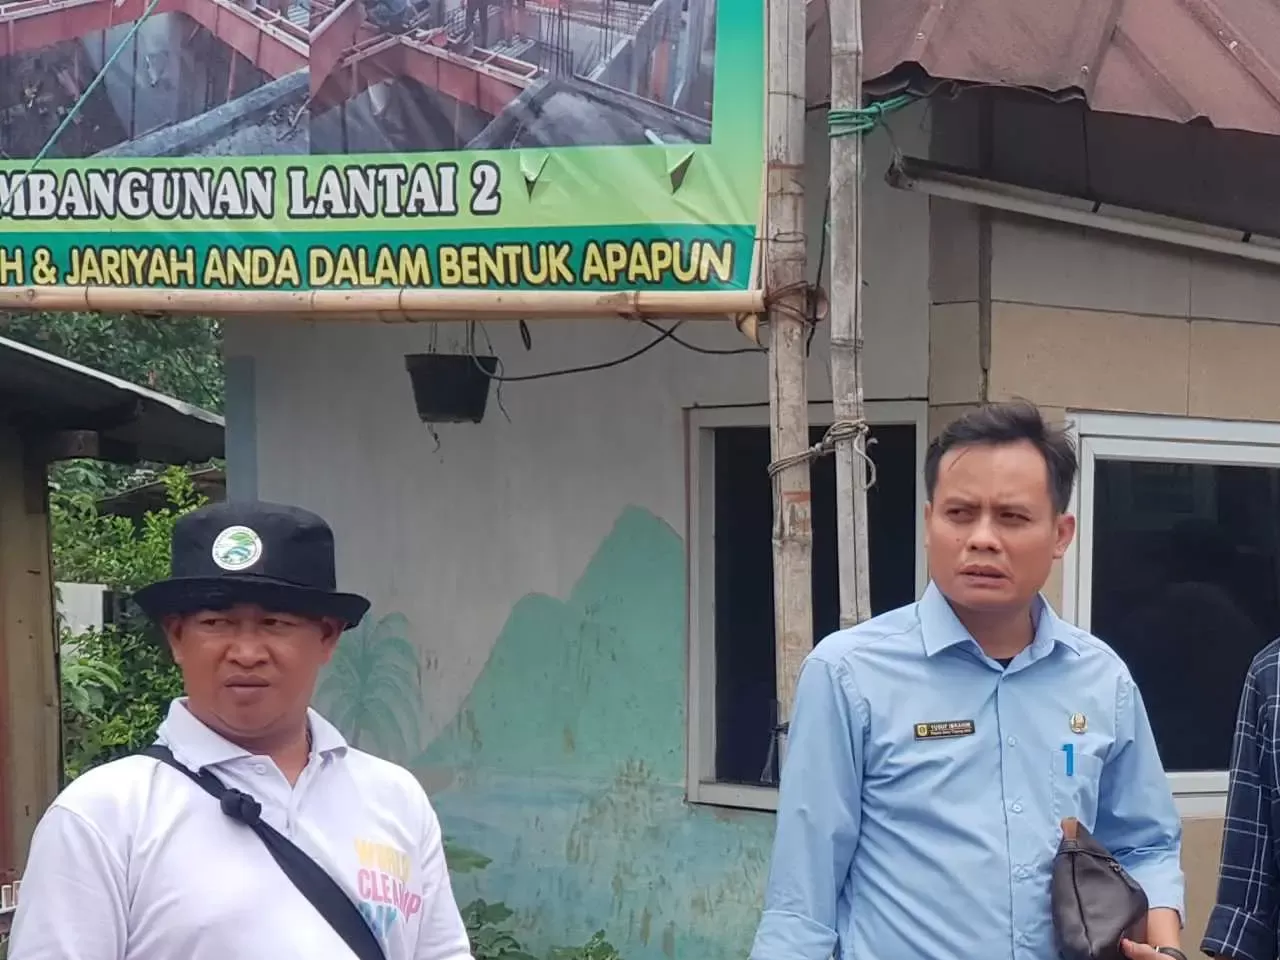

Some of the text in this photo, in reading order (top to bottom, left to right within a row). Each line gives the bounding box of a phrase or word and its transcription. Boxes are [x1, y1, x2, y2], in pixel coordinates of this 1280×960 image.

[288, 163, 458, 217] LANTAI
[470, 162, 501, 214] 2
[32, 247, 58, 286] &
[66, 246, 196, 286] JARIYAH
[203, 246, 301, 287] ANDA
[309, 245, 432, 287] DALAM
[439, 243, 575, 286] BENTUK
[582, 240, 734, 284] APAPUN
